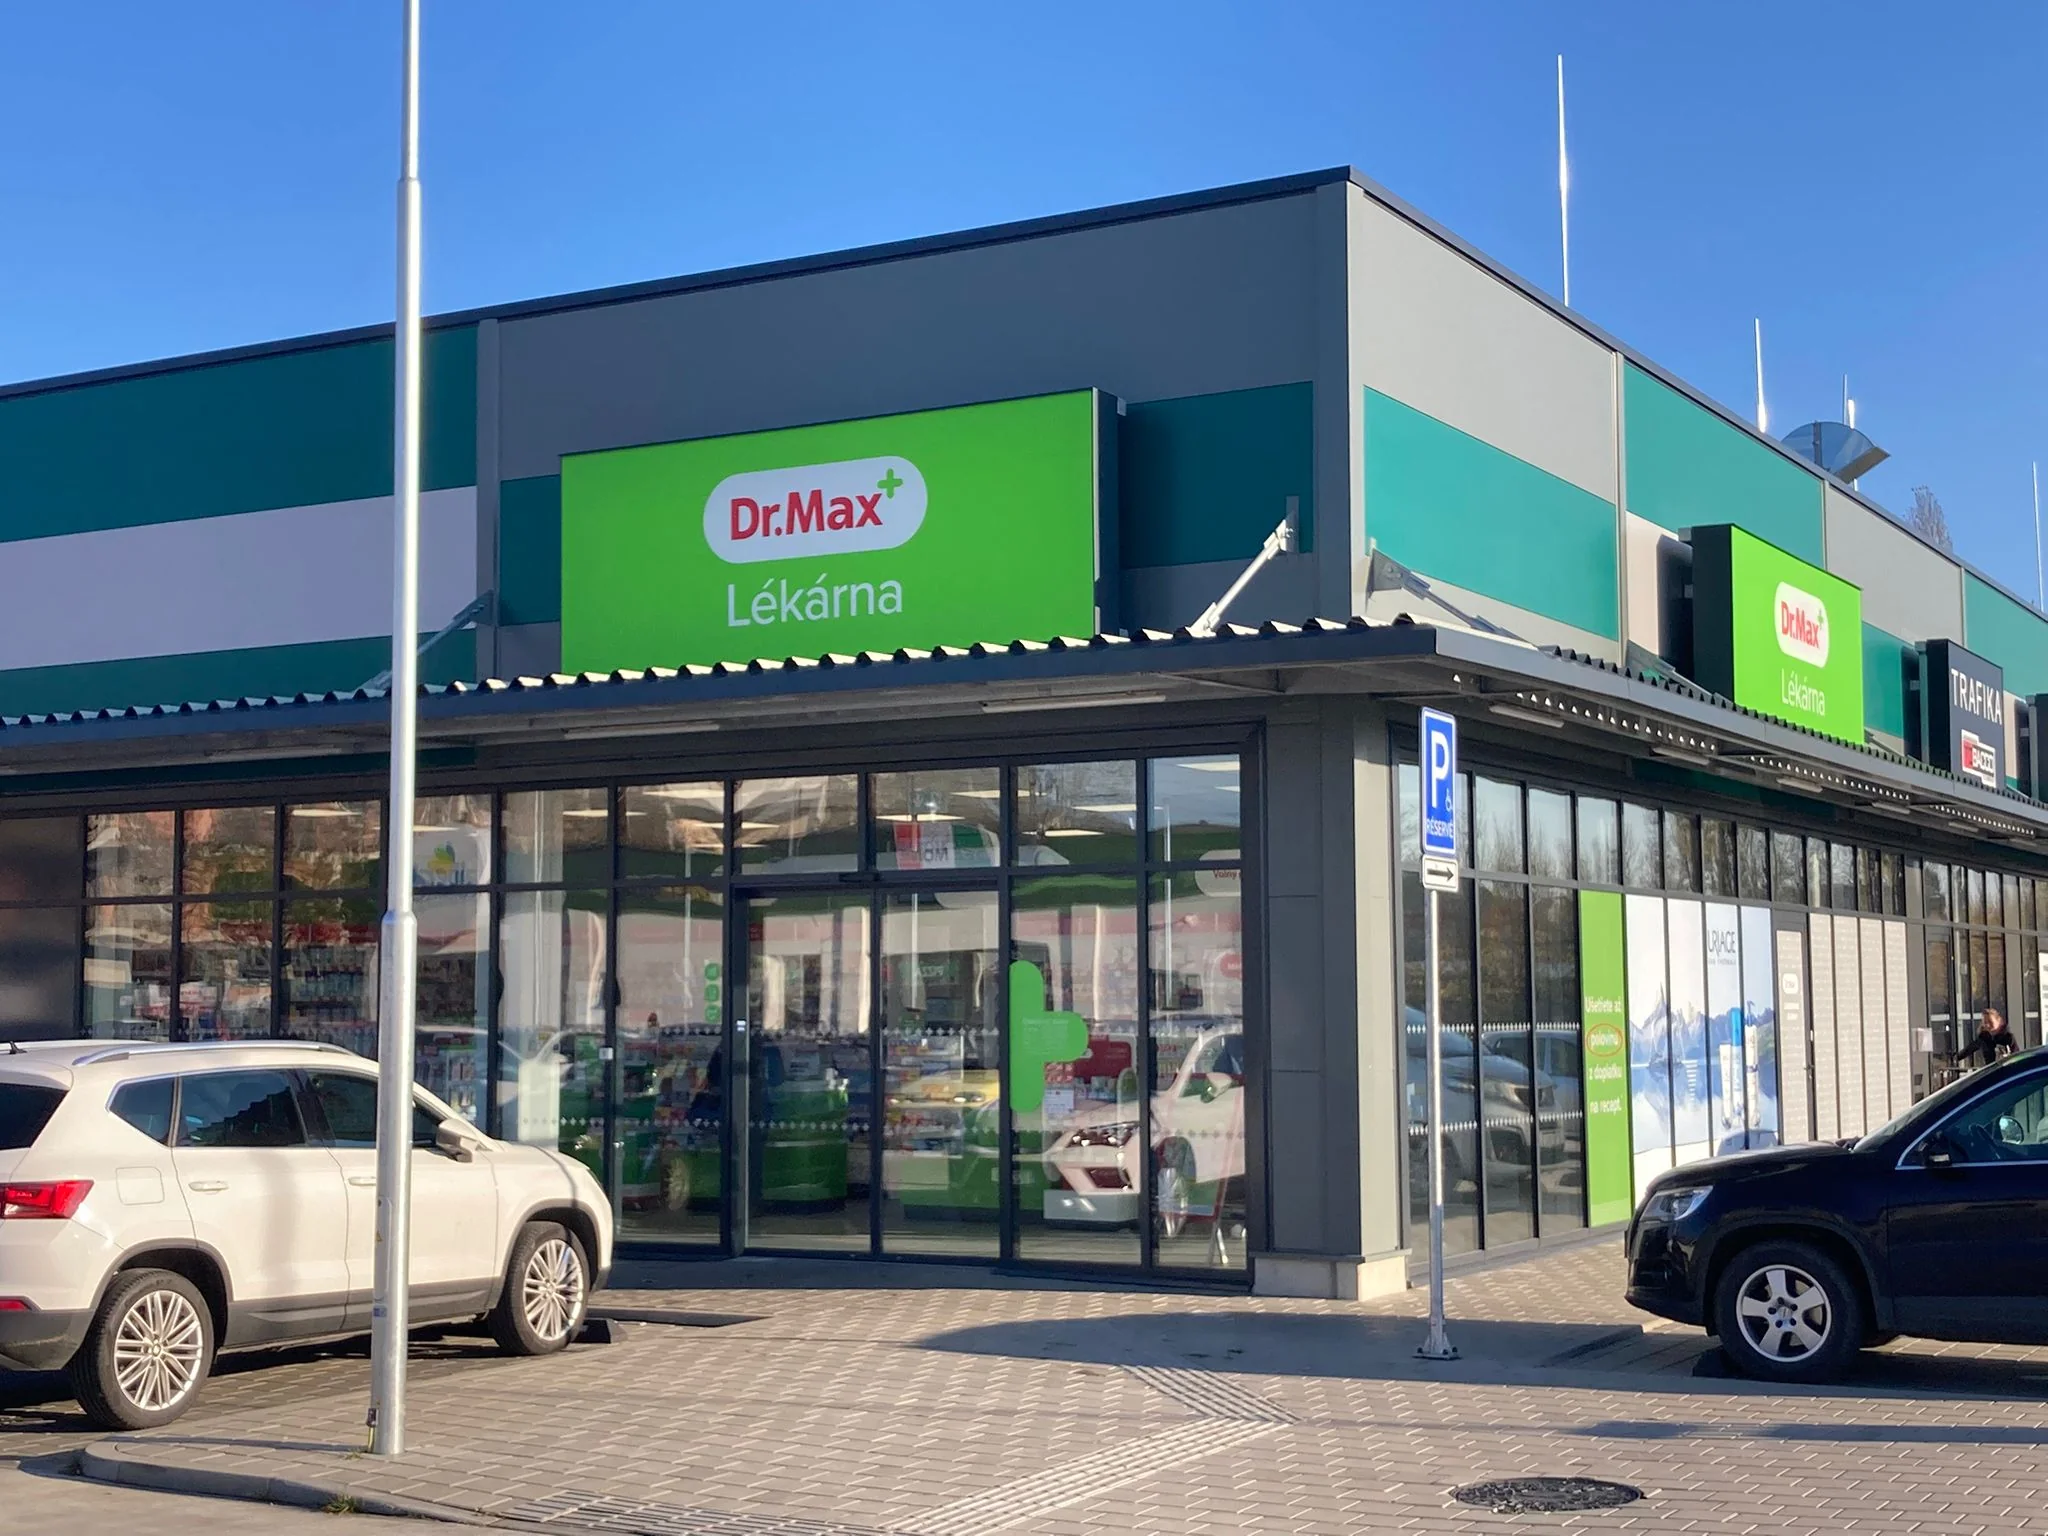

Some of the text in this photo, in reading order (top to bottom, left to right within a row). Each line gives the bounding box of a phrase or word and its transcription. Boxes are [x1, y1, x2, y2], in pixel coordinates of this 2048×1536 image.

[731, 489, 883, 540] Dr.Max
[728, 573, 903, 627] Lékárna
[1781, 600, 1820, 649] Dr.Max
[1782, 668, 1826, 716] Lékárna
[1951, 668, 2003, 725] TRAFIKA
[1431, 730, 1450, 808] P
